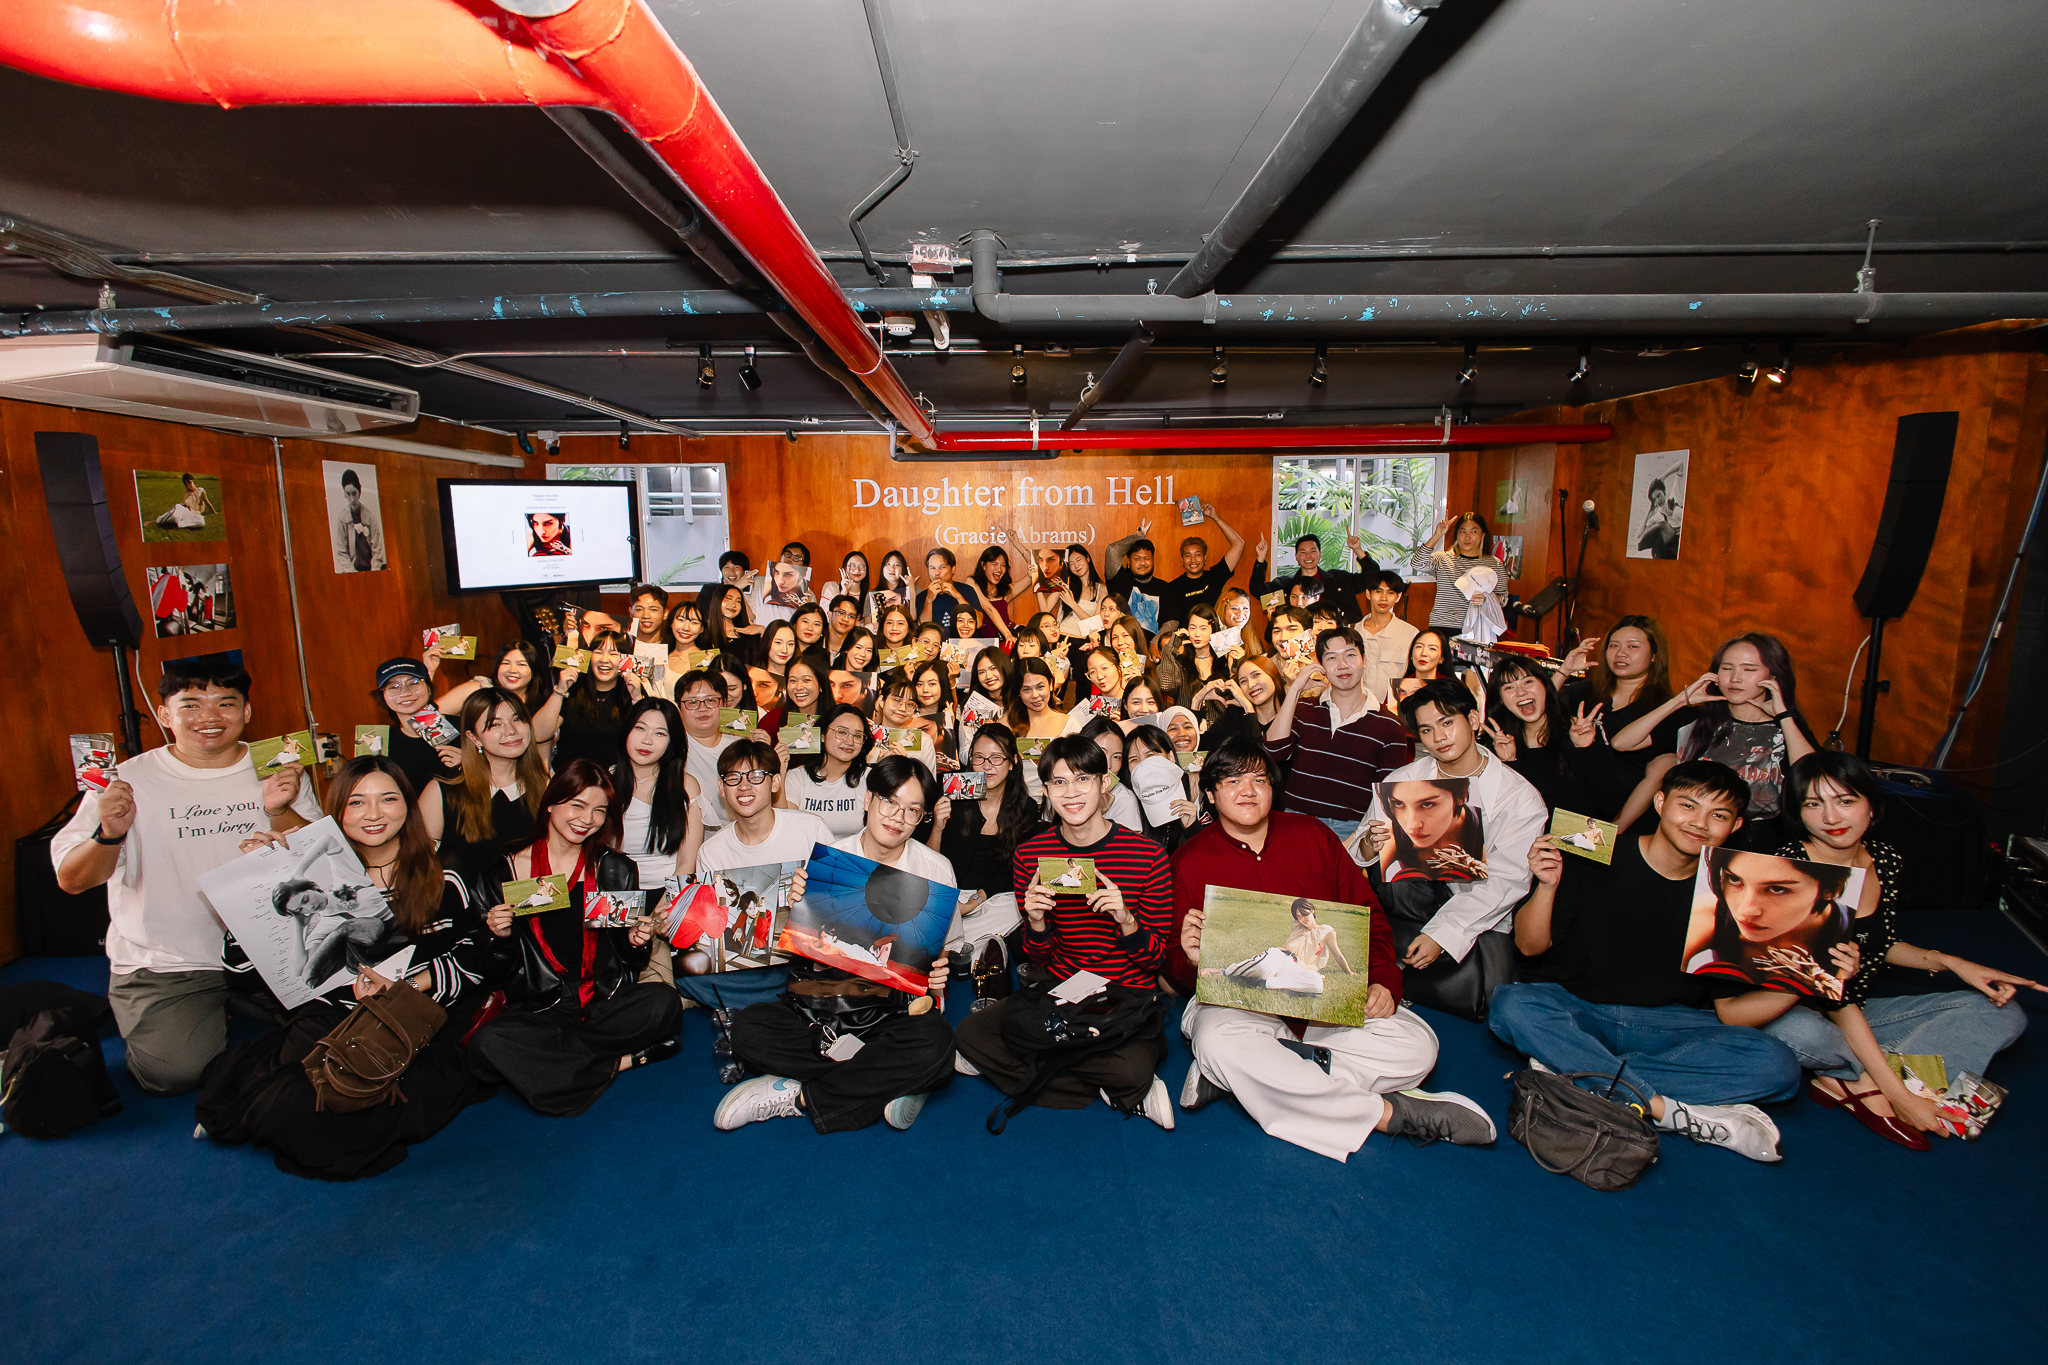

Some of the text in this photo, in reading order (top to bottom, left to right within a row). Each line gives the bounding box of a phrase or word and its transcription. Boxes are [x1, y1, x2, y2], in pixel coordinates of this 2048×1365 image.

[852, 474, 1176, 515] Daughter from Hell
[934, 523, 1096, 547] (Gracie Abrams)
[169, 801, 260, 820] I Love you,
[804, 798, 856, 812] THATS HOT
[209, 821, 256, 835] Sorry
